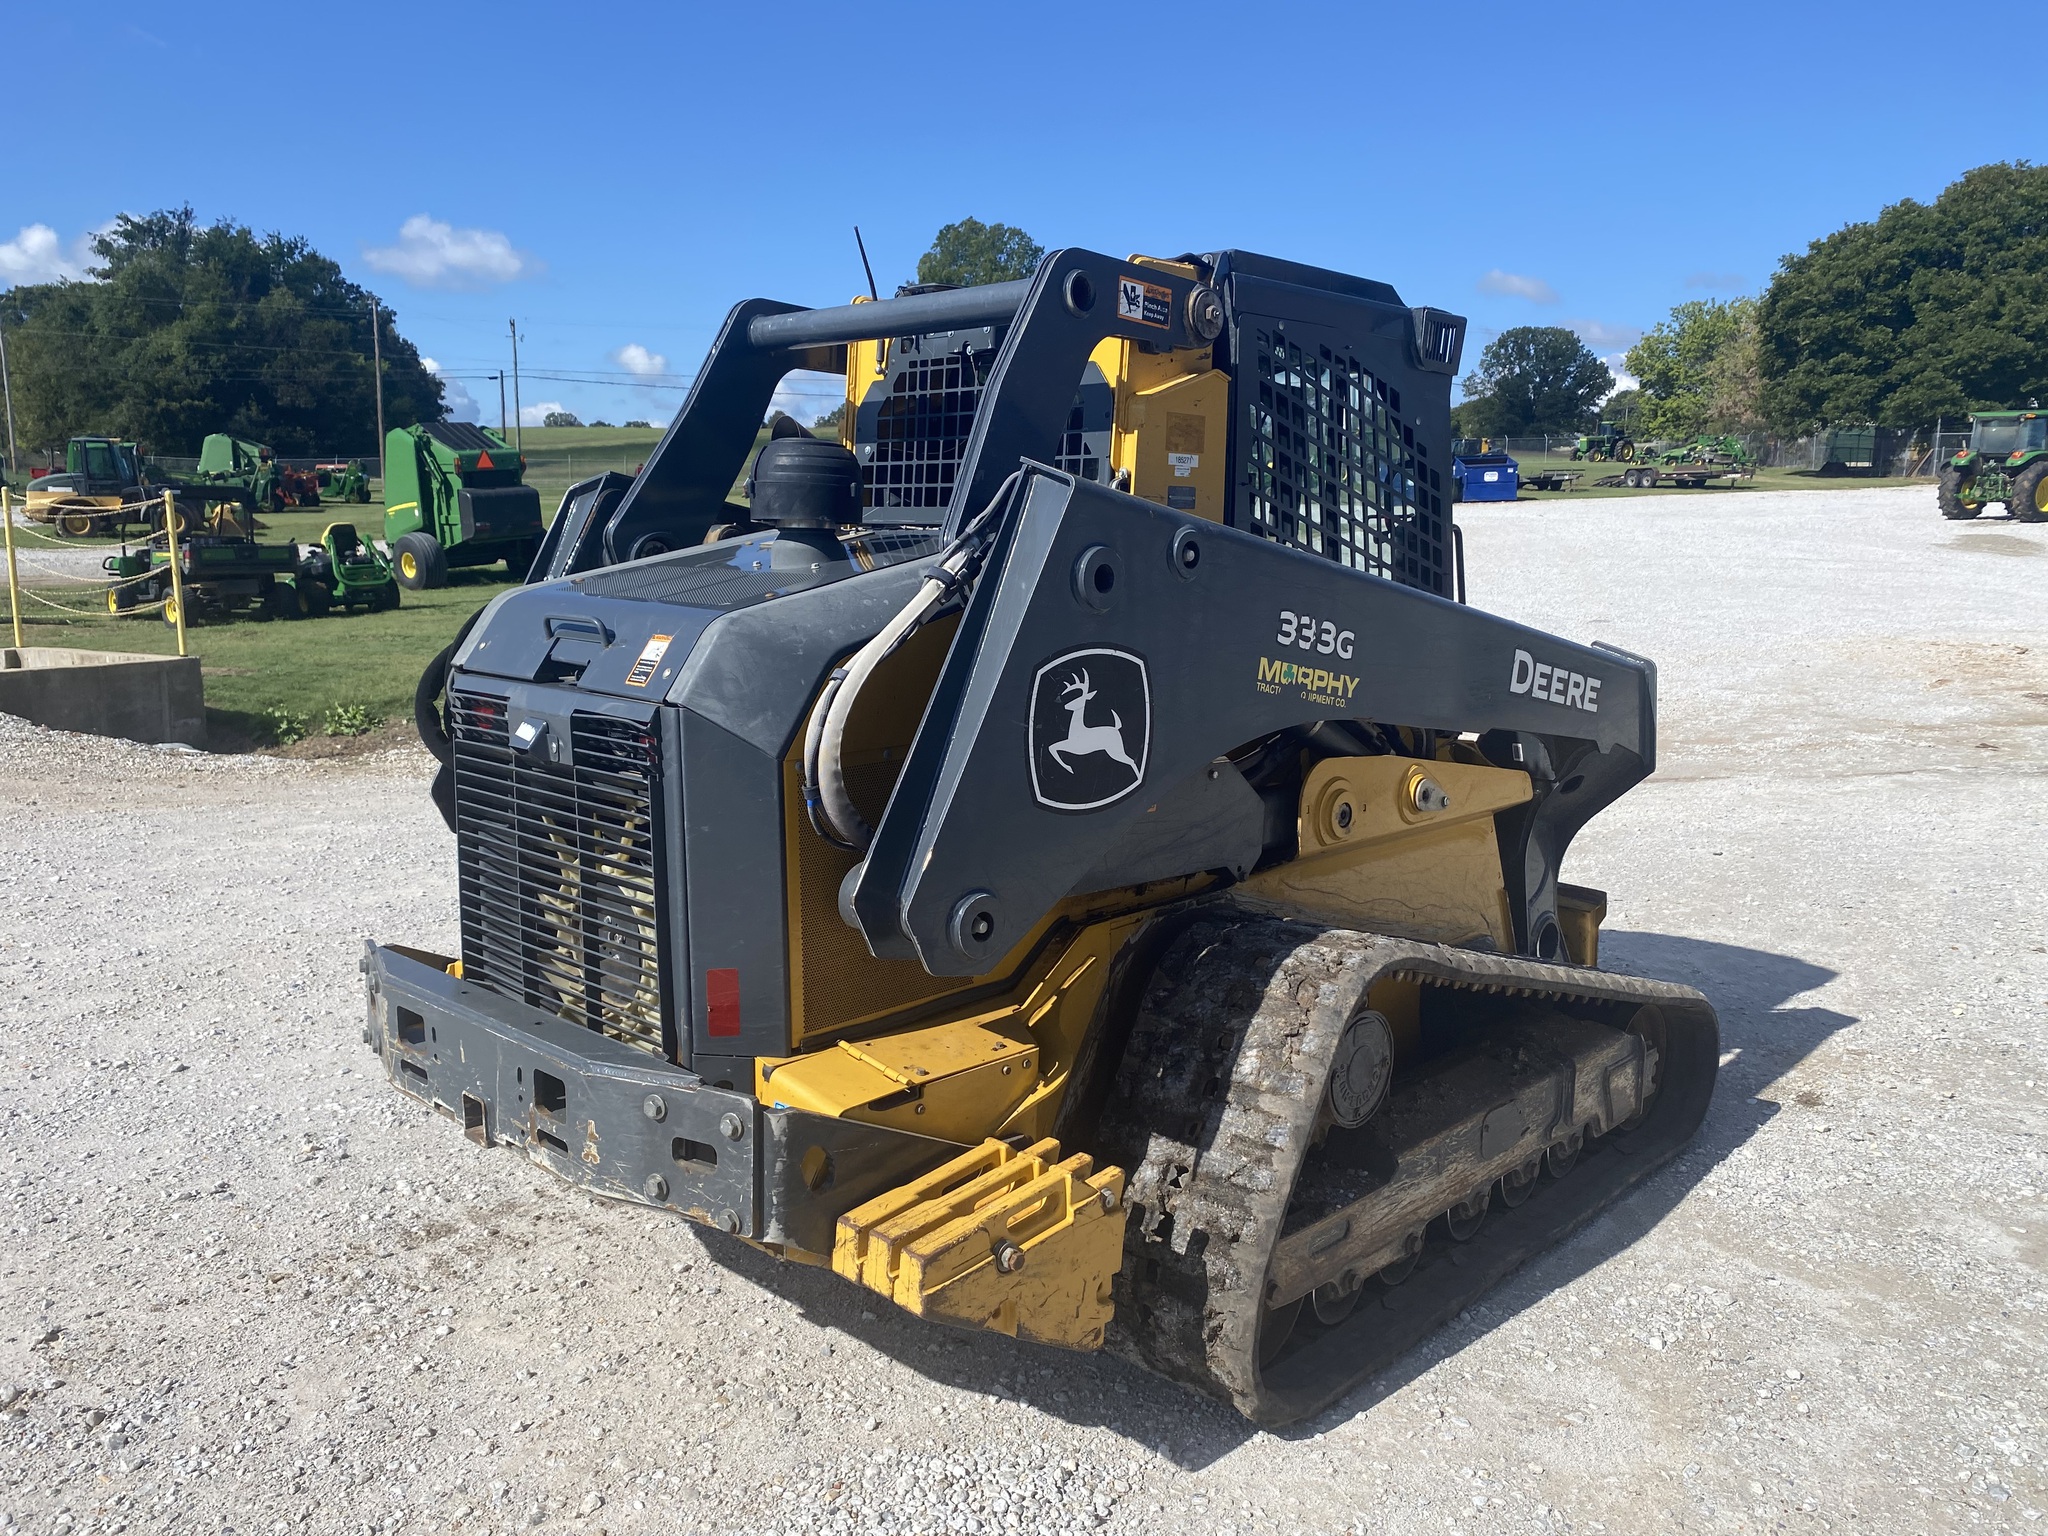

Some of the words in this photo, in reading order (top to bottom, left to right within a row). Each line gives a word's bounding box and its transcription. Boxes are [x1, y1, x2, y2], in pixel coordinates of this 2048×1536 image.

[1277, 610, 1355, 660] 333G
[1257, 656, 1361, 698] MURPHY
[1509, 648, 1602, 713] DEERE
